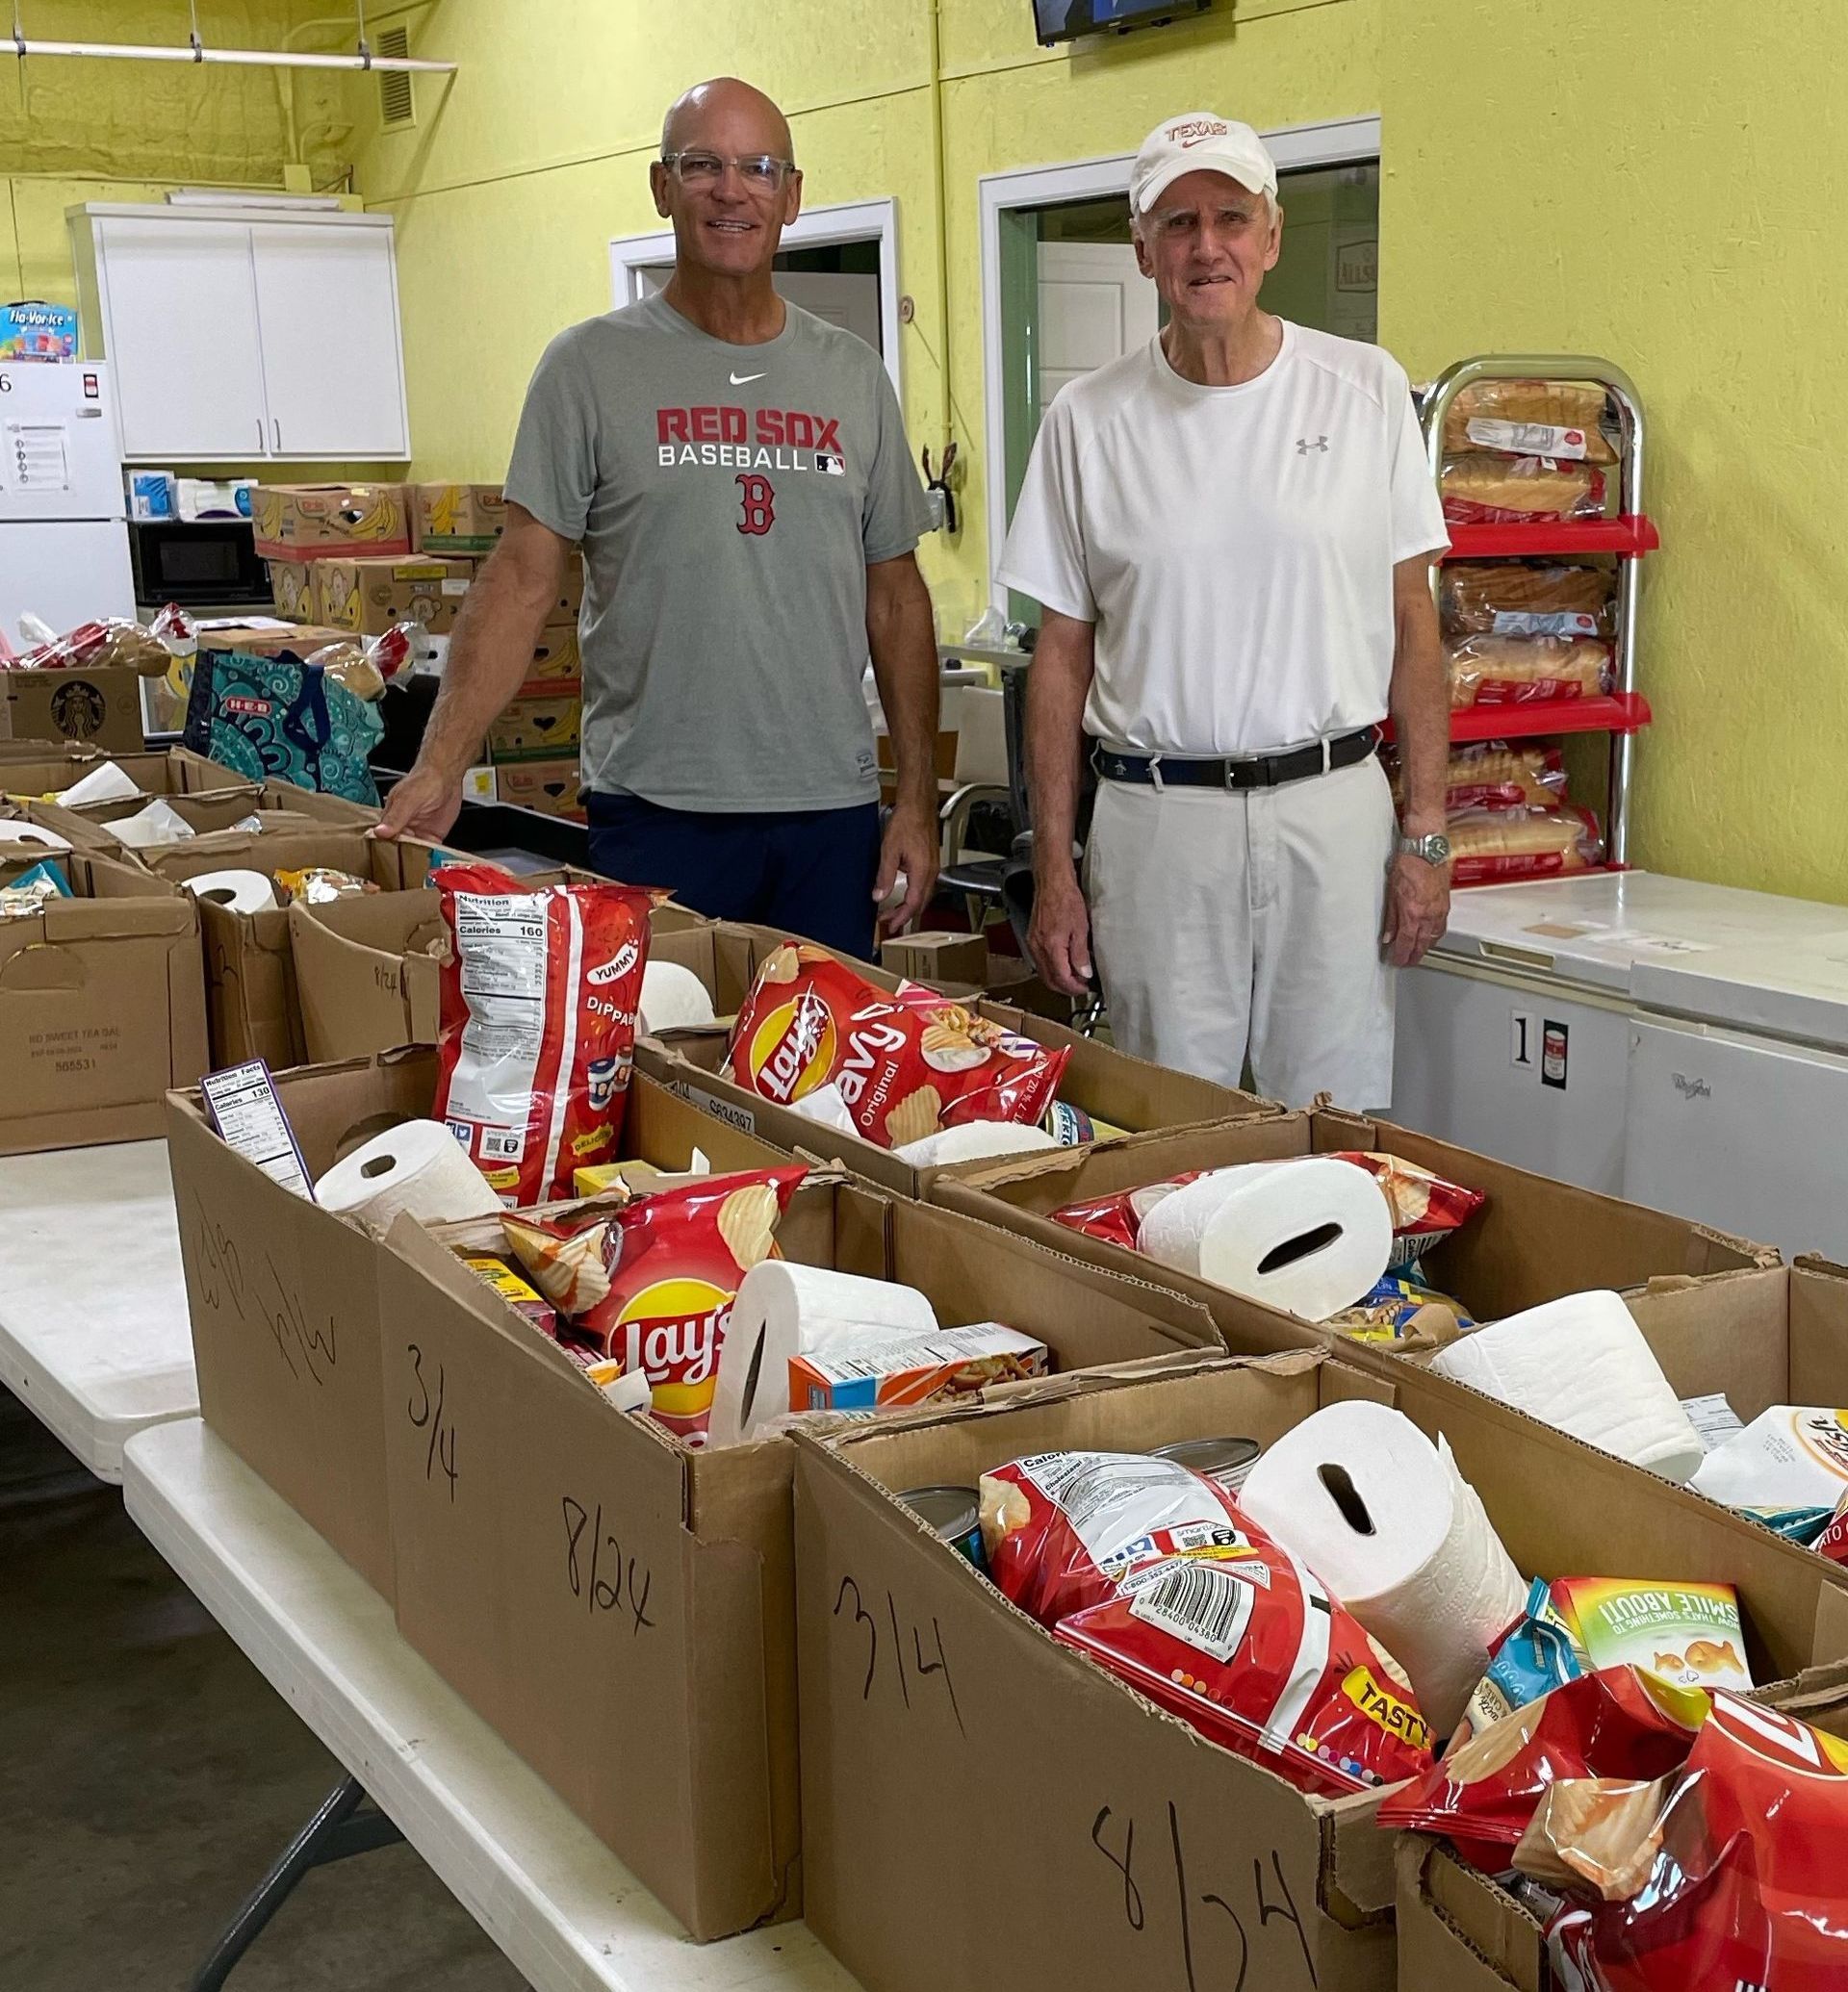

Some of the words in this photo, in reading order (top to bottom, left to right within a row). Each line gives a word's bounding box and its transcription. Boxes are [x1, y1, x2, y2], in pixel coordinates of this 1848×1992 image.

[1166, 121, 1227, 141] TEXAS
[0, 373, 12, 393] 6
[656, 407, 747, 445] RED
[756, 409, 843, 454] SOX
[658, 445, 808, 471] BASEBALL
[734, 473, 776, 536] B
[459, 895, 510, 907] Nutrition
[459, 926, 501, 934] Calories
[520, 926, 544, 937] 160
[595, 949, 635, 981] YUMMY
[1514, 1017, 1531, 1064] 1
[206, 1072, 238, 1087] Nutrition
[241, 1064, 261, 1076] Facts
[834, 1022, 907, 1106] avy
[216, 1097, 243, 1111] Calories
[251, 1086, 270, 1099] 130
[860, 1060, 900, 1127] Original
[407, 1343, 458, 1504] 3/4
[563, 1495, 656, 1637] 8/24
[1598, 1592, 1673, 1625] ABOUT!
[1627, 1610, 1681, 1629] SOMETHING
[1675, 1593, 1740, 1623] SMILE
[1155, 1605, 1186, 1626] 28400
[1188, 1622, 1218, 1644] 04380
[1612, 1624, 1628, 1635] TO
[834, 1575, 966, 1740] 3/4
[1360, 1681, 1429, 1744] TASTY
